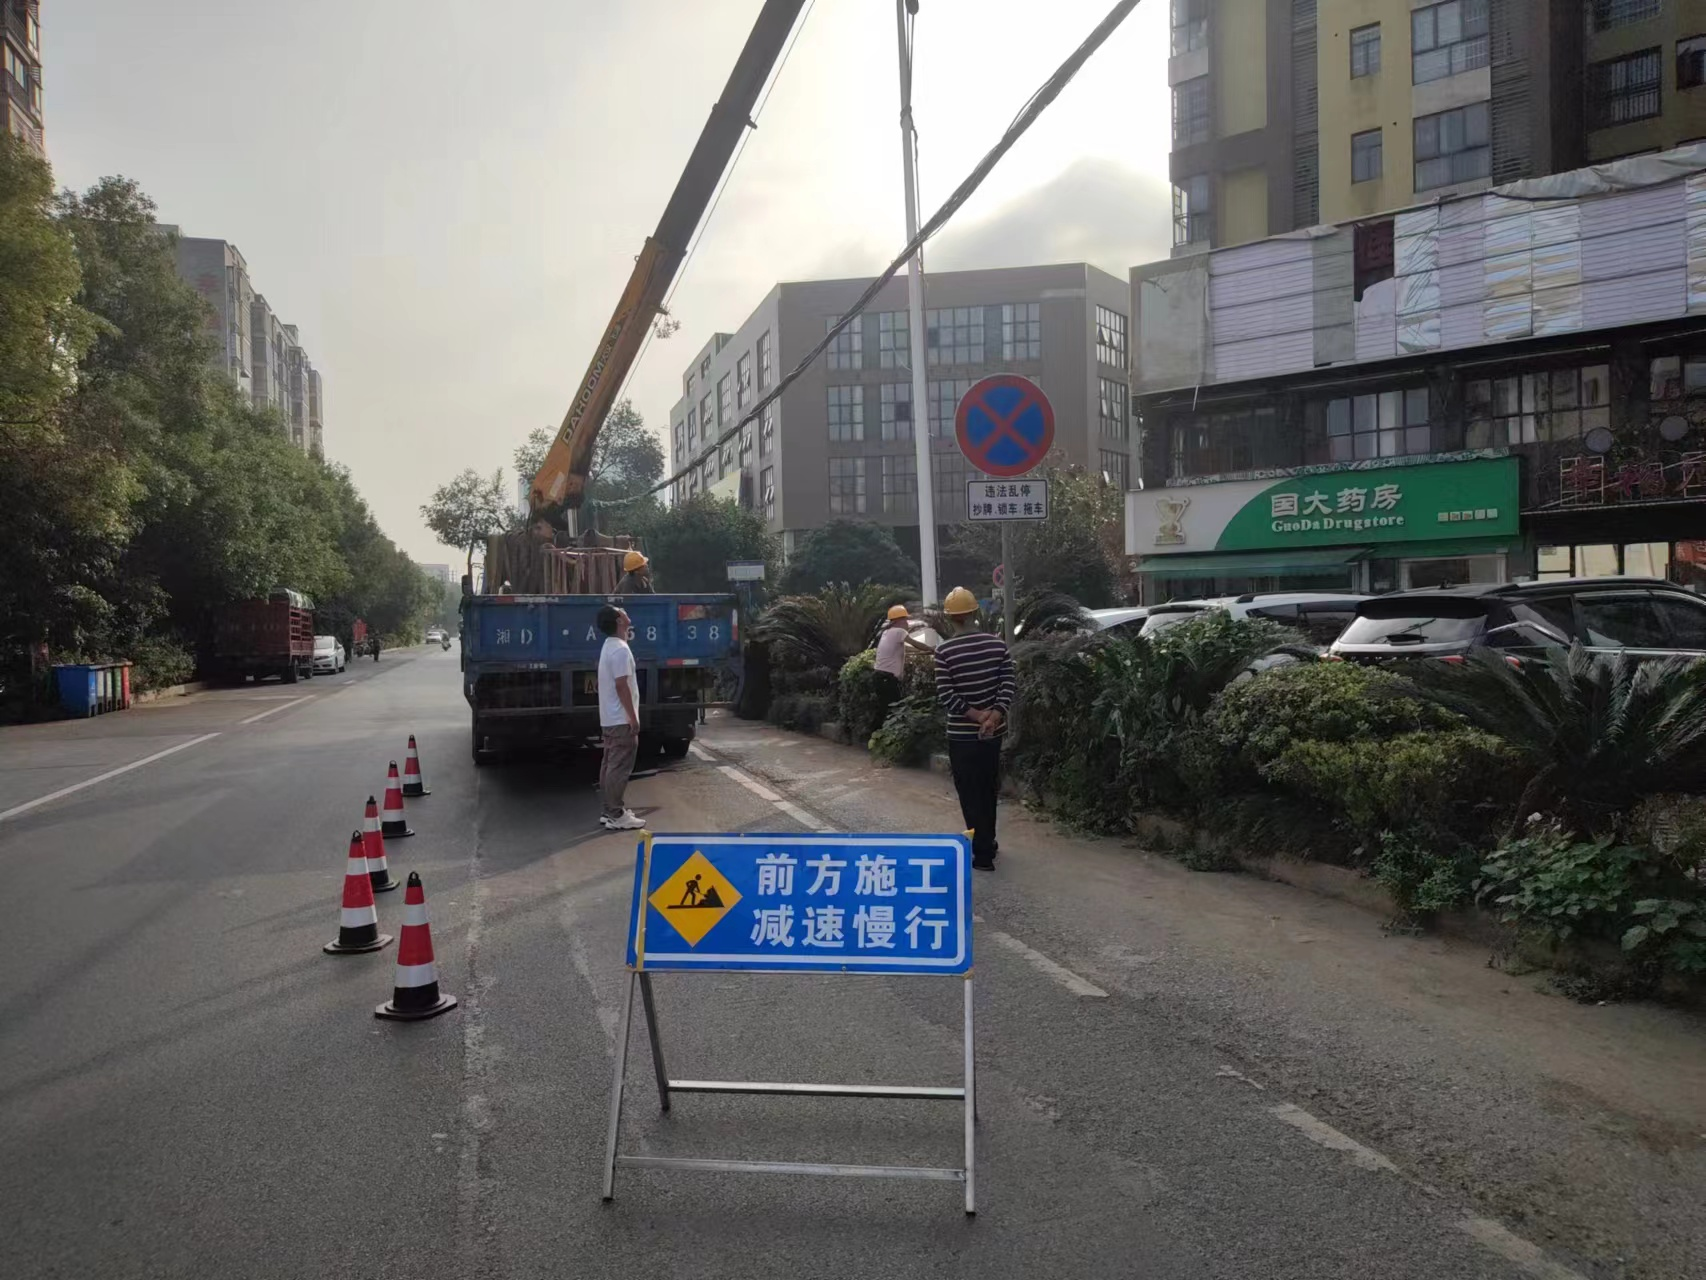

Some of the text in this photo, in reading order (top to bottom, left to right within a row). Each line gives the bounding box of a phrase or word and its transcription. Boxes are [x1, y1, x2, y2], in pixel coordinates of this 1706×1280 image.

[985, 485, 1031, 498] 违法乱停
[1271, 484, 1402, 516] 国大药房
[1271, 514, 1404, 533] GuoDa Drugstore
[755, 853, 948, 896] 前方施工
[750, 905, 949, 950] 减速慢行
